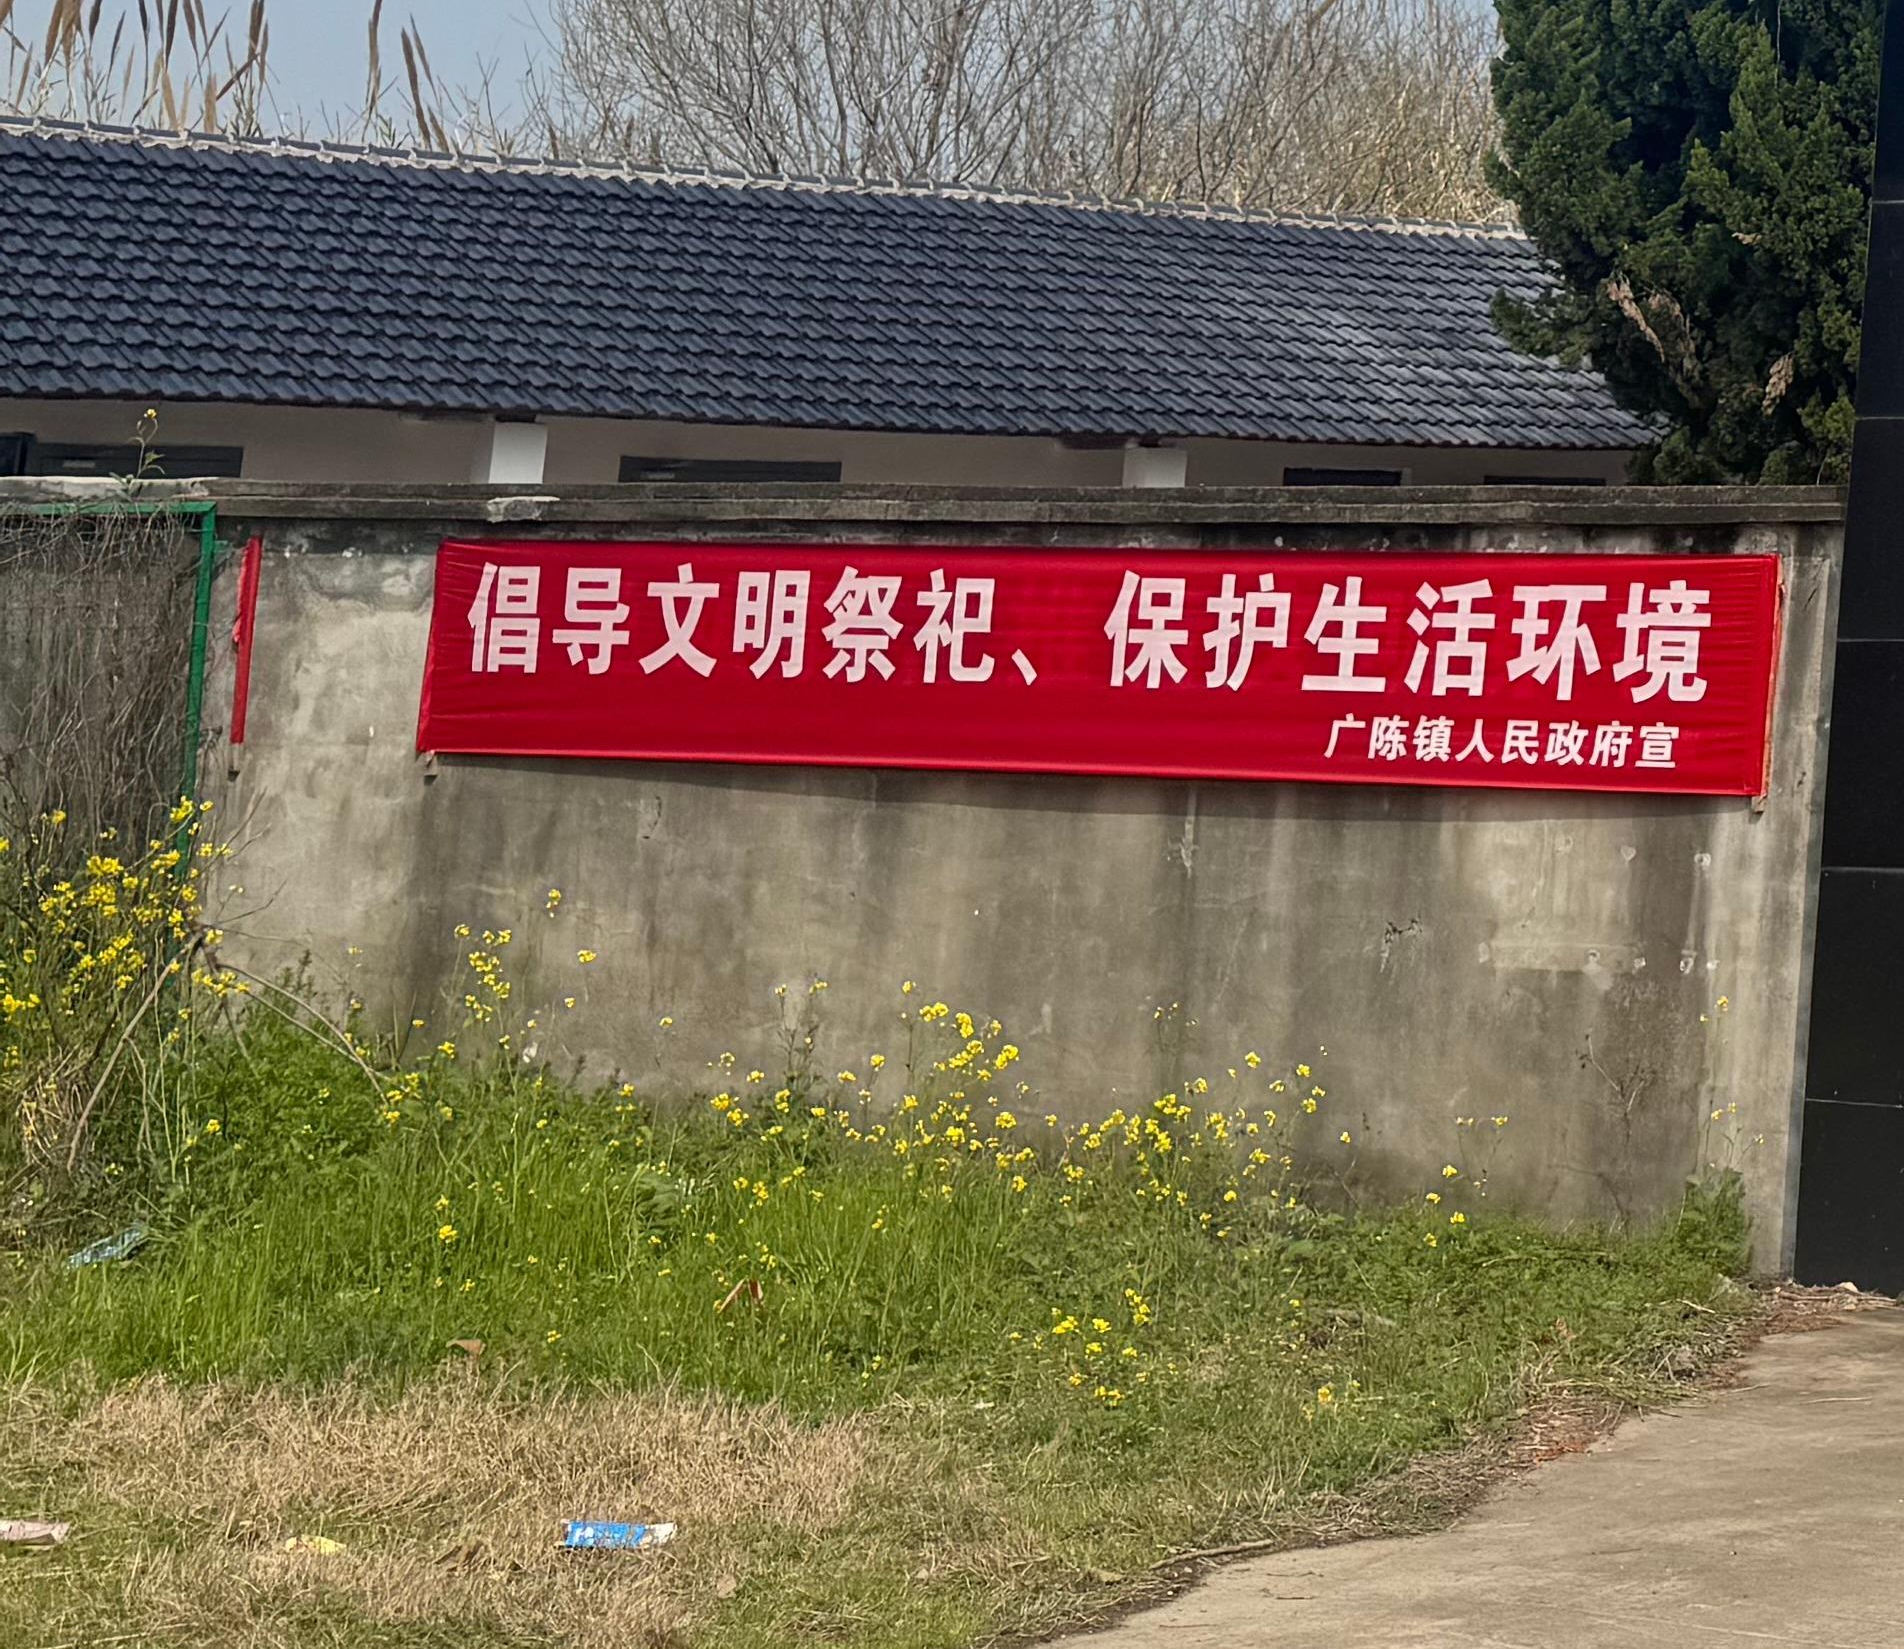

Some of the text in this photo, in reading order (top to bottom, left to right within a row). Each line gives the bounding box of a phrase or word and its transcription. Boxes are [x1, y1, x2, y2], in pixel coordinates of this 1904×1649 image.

[468, 562, 1711, 703] 倡导文明祭祀、保护生活环境
[1323, 713, 1680, 769] 广陈镇人民政府宣
